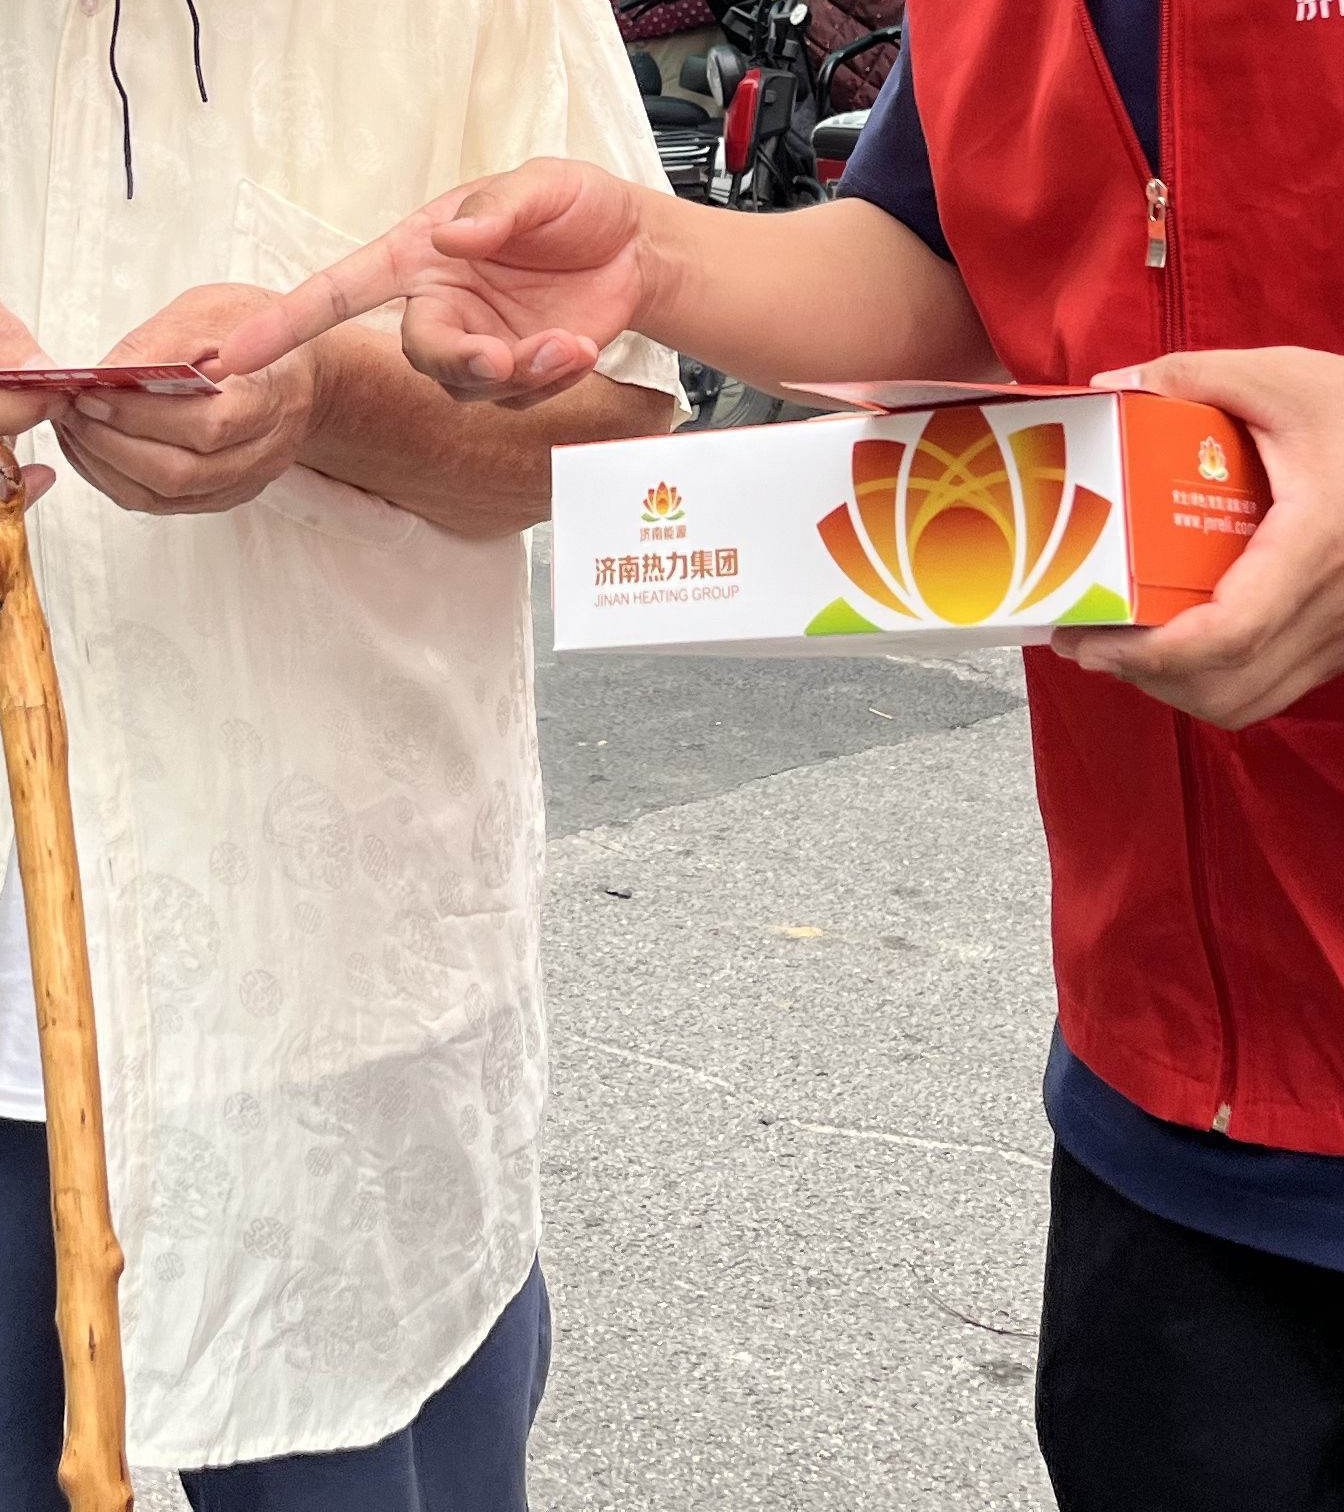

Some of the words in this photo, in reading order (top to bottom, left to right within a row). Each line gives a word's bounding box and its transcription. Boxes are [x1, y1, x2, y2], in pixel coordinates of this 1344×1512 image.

[640, 525, 687, 542] 济南能源
[595, 548, 739, 586] 济南热力集团
[633, 588, 689, 605] HEATING
[692, 585, 740, 601] GROUP
